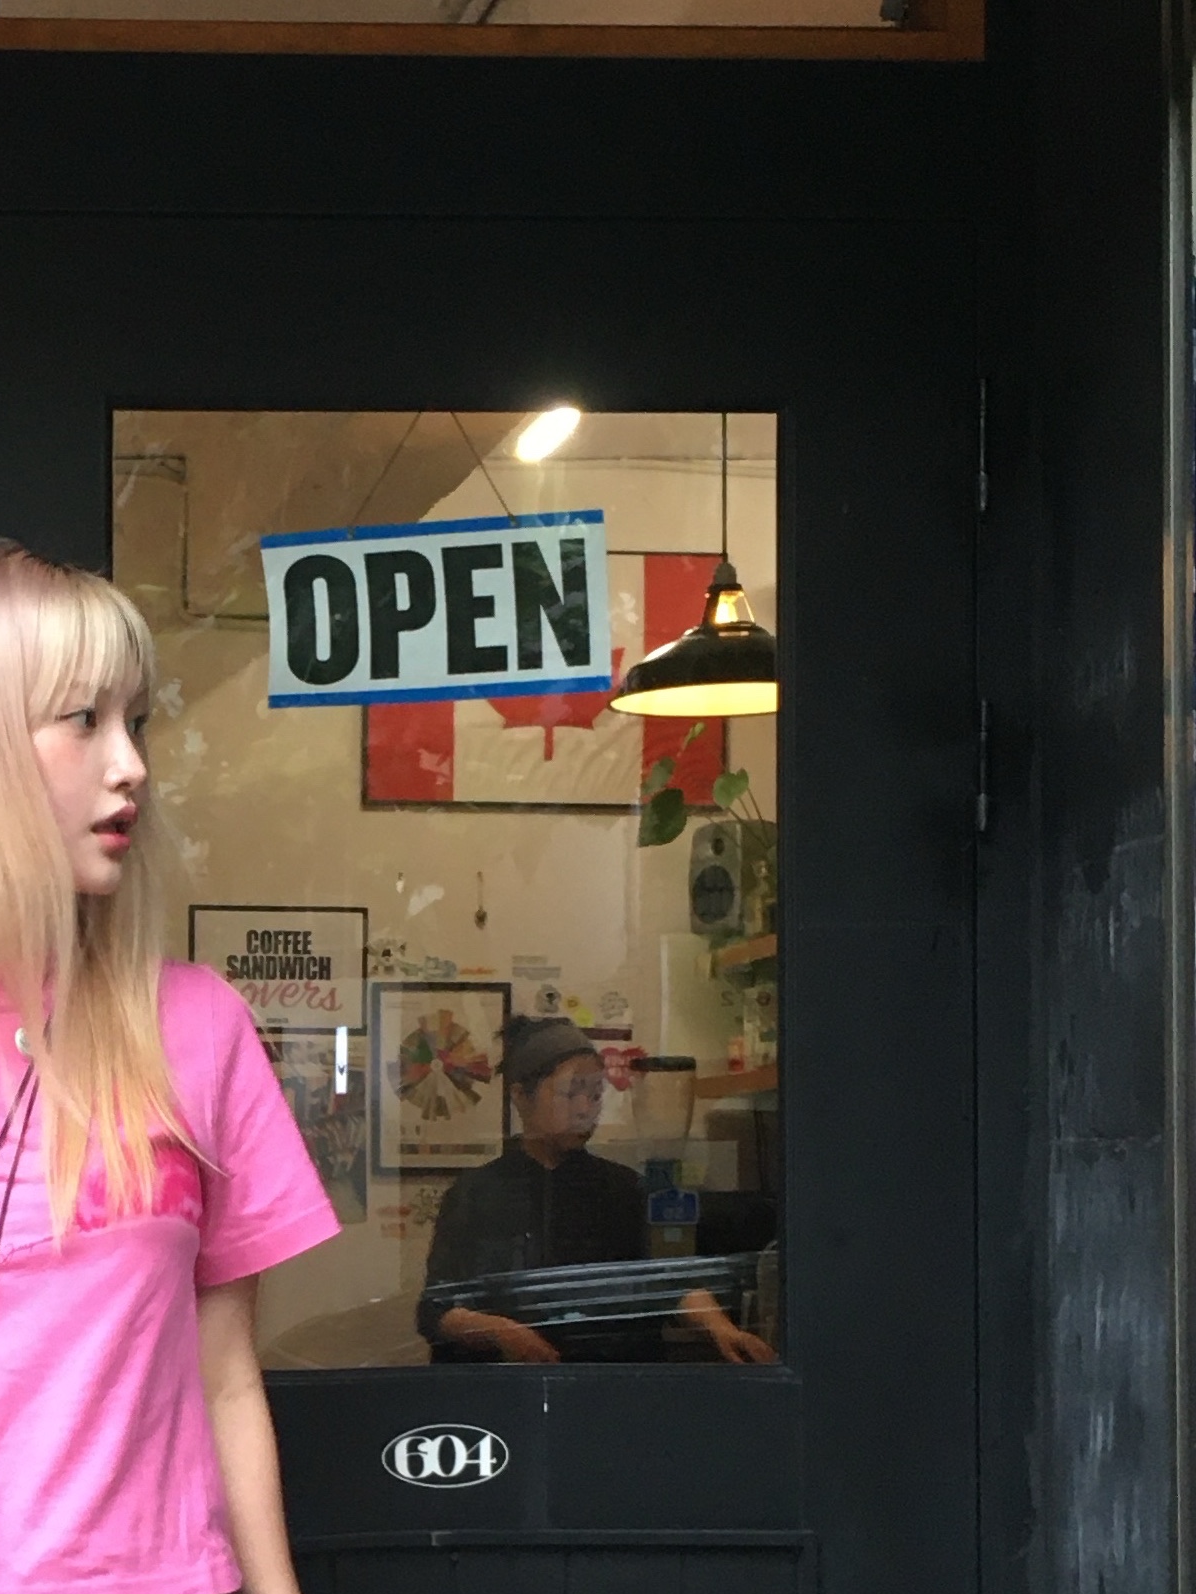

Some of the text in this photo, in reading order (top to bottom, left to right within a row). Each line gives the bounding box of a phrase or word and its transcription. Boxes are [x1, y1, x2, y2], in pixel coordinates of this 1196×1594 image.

[283, 538, 591, 686] OPEN
[246, 929, 312, 955] COFFEE
[226, 954, 332, 981] SANDWICH
[232, 979, 344, 1012] overs
[393, 1433, 498, 1479] 604
